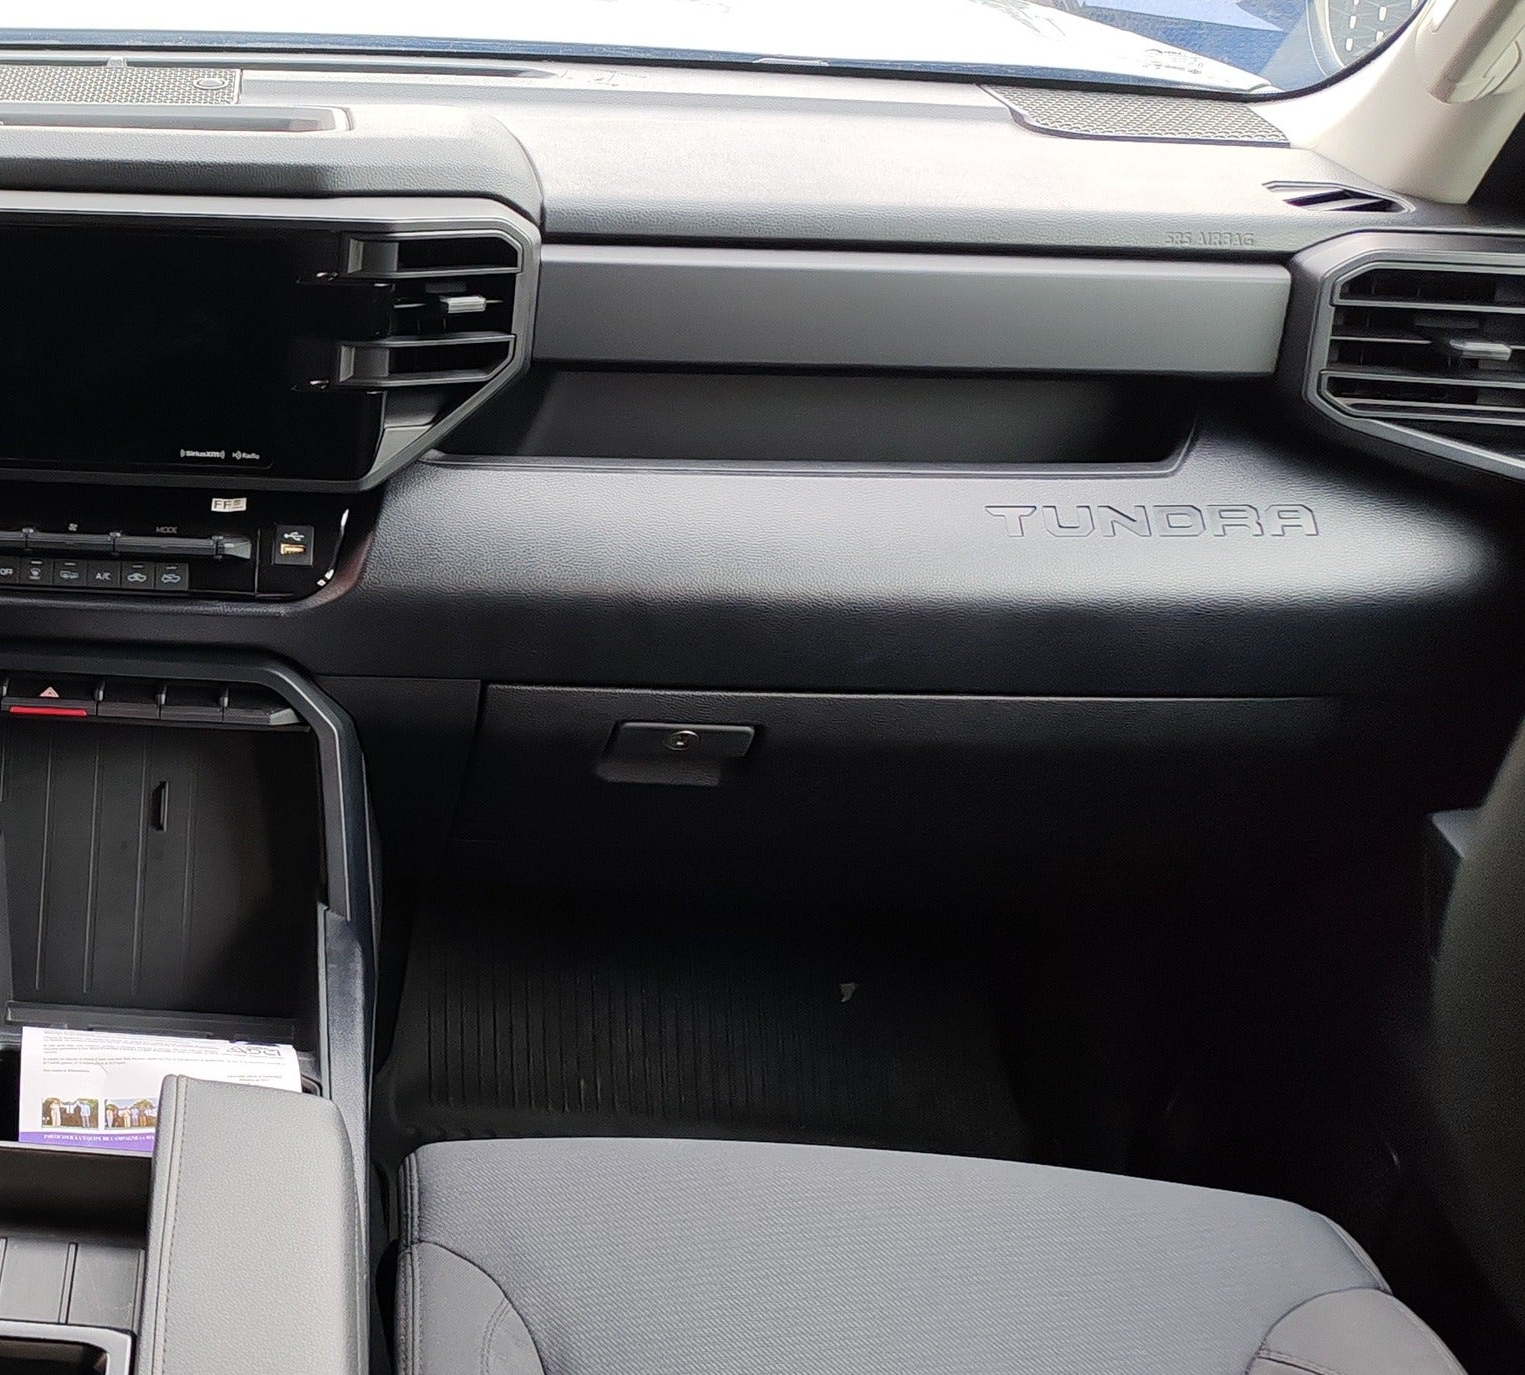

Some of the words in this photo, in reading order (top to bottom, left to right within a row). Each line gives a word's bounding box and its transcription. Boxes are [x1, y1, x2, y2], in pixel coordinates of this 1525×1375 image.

[1164, 231, 1191, 245] SRS
[1197, 231, 1255, 246] AIRBAG
[984, 503, 1320, 538] TUNDRA
[0, 568, 14, 576] OFF
[96, 572, 111, 580] A/C
